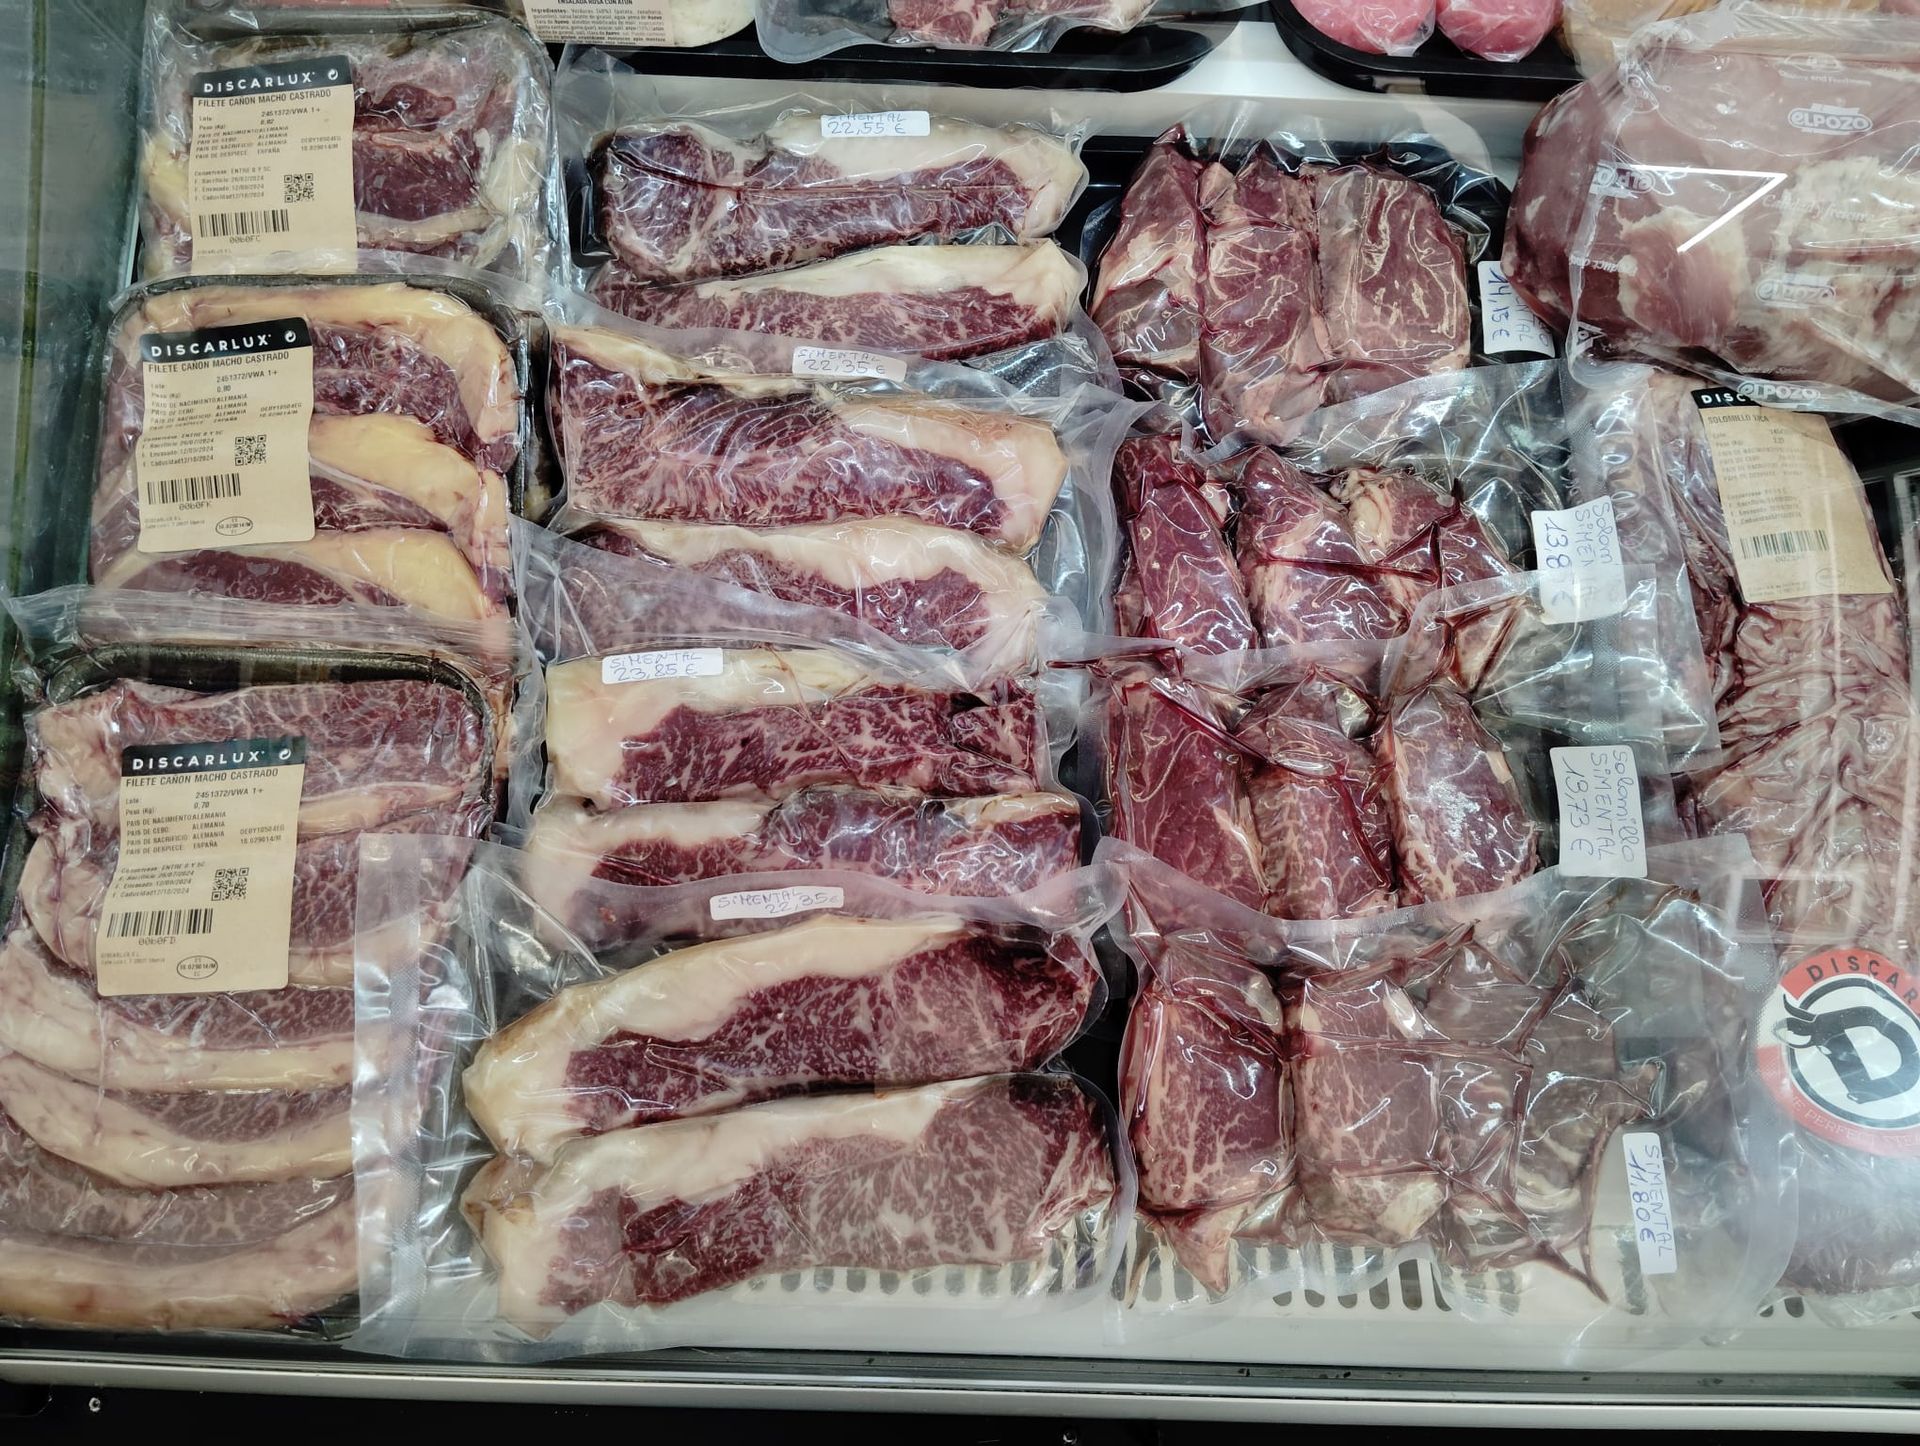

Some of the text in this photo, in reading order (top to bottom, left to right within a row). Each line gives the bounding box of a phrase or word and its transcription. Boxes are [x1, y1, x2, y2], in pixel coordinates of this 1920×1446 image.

[203, 71, 312, 93] DISCARLUX
[198, 98, 226, 108] FILETE
[258, 94, 287, 104] MACHO
[289, 88, 332, 101] CASTRADO
[828, 121, 885, 135] 22,55
[151, 334, 268, 357] DISCARLUX
[148, 363, 178, 374] FILETE
[212, 356, 242, 367] MACHO
[245, 351, 290, 364] CASTRADO
[803, 359, 872, 374] 22,35
[1700, 393, 1747, 404] DISC
[613, 663, 679, 681] 23,85
[132, 750, 259, 770] DISCARLUX
[126, 777, 157, 787] FILETE
[194, 772, 228, 783] MACHO
[230, 768, 279, 781] CASTRADO
[1628, 1148, 1651, 1222] 11,80
